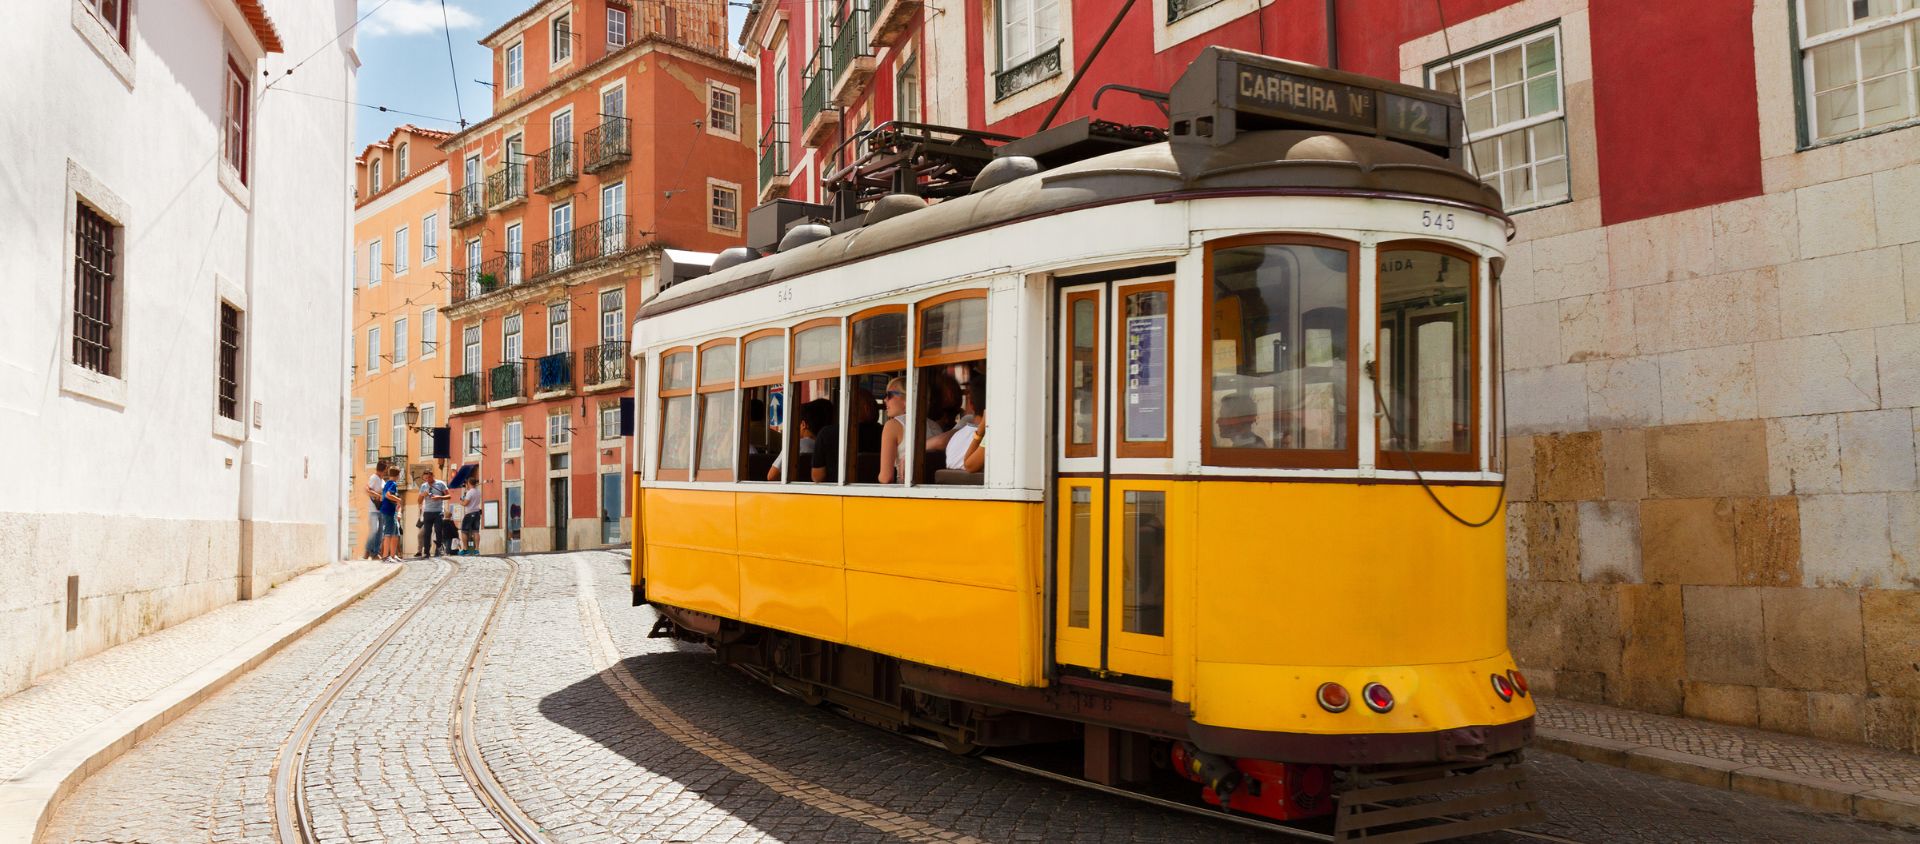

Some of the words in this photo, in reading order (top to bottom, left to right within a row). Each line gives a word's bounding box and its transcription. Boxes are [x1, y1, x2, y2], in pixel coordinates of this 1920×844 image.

[1240, 71, 1338, 113] CARREIRA
[1397, 98, 1430, 134] 12
[1422, 210, 1455, 231] 545
[1381, 257, 1413, 272] AÍDA
[778, 288, 793, 303] 545
